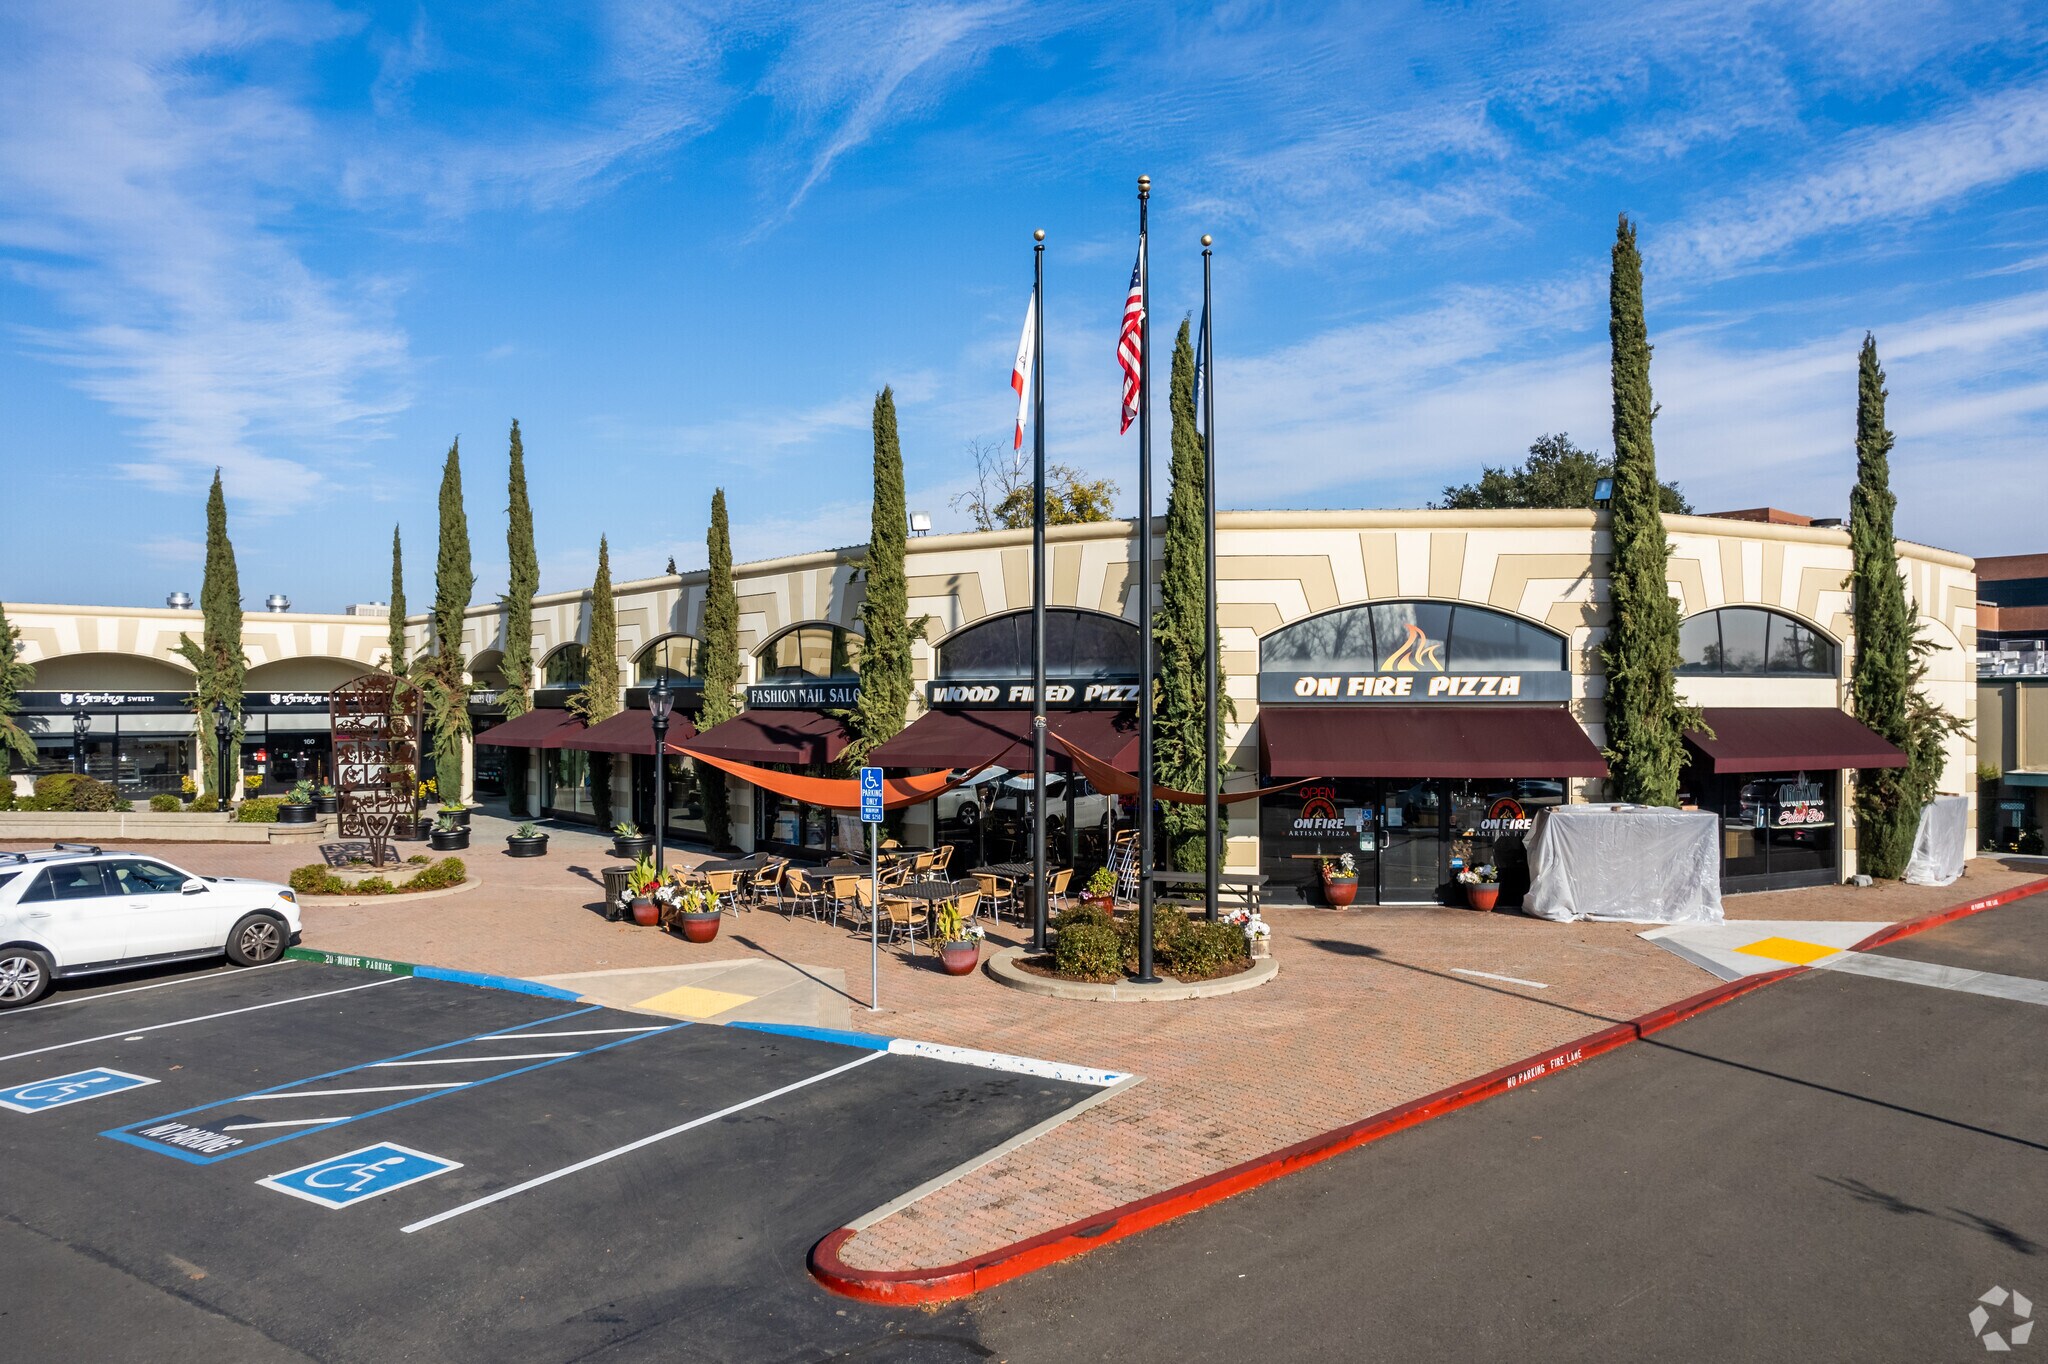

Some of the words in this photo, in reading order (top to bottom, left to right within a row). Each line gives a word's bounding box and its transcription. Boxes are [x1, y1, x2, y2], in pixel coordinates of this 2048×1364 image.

[1295, 676, 1341, 697] ON
[1347, 676, 1414, 697] FIRE
[1428, 675, 1521, 697] PIZZA
[751, 689, 796, 703] FASHION
[799, 688, 826, 703] NAIL
[829, 688, 861, 702] SALO
[933, 686, 1000, 703] WOOD
[1008, 685, 1075, 703] FIED
[1084, 684, 1139, 702] PIZZ
[862, 789, 882, 797] PARKING
[1300, 787, 1336, 799] OPEN
[866, 798, 878, 806] ONLY
[1293, 818, 1314, 829] ON
[1314, 818, 1345, 829] FIRE
[1480, 818, 1501, 830] ON
[1501, 818, 1533, 830] FIRE
[365, 960, 393, 972] PARKING
[1507, 1077, 1517, 1088] NO
[1518, 1064, 1545, 1083] PARKING
[1550, 1055, 1565, 1069] FIRE
[1566, 1049, 1582, 1062] LANE
[139, 1121, 189, 1137] NO
[159, 1127, 244, 1153] PARKING
